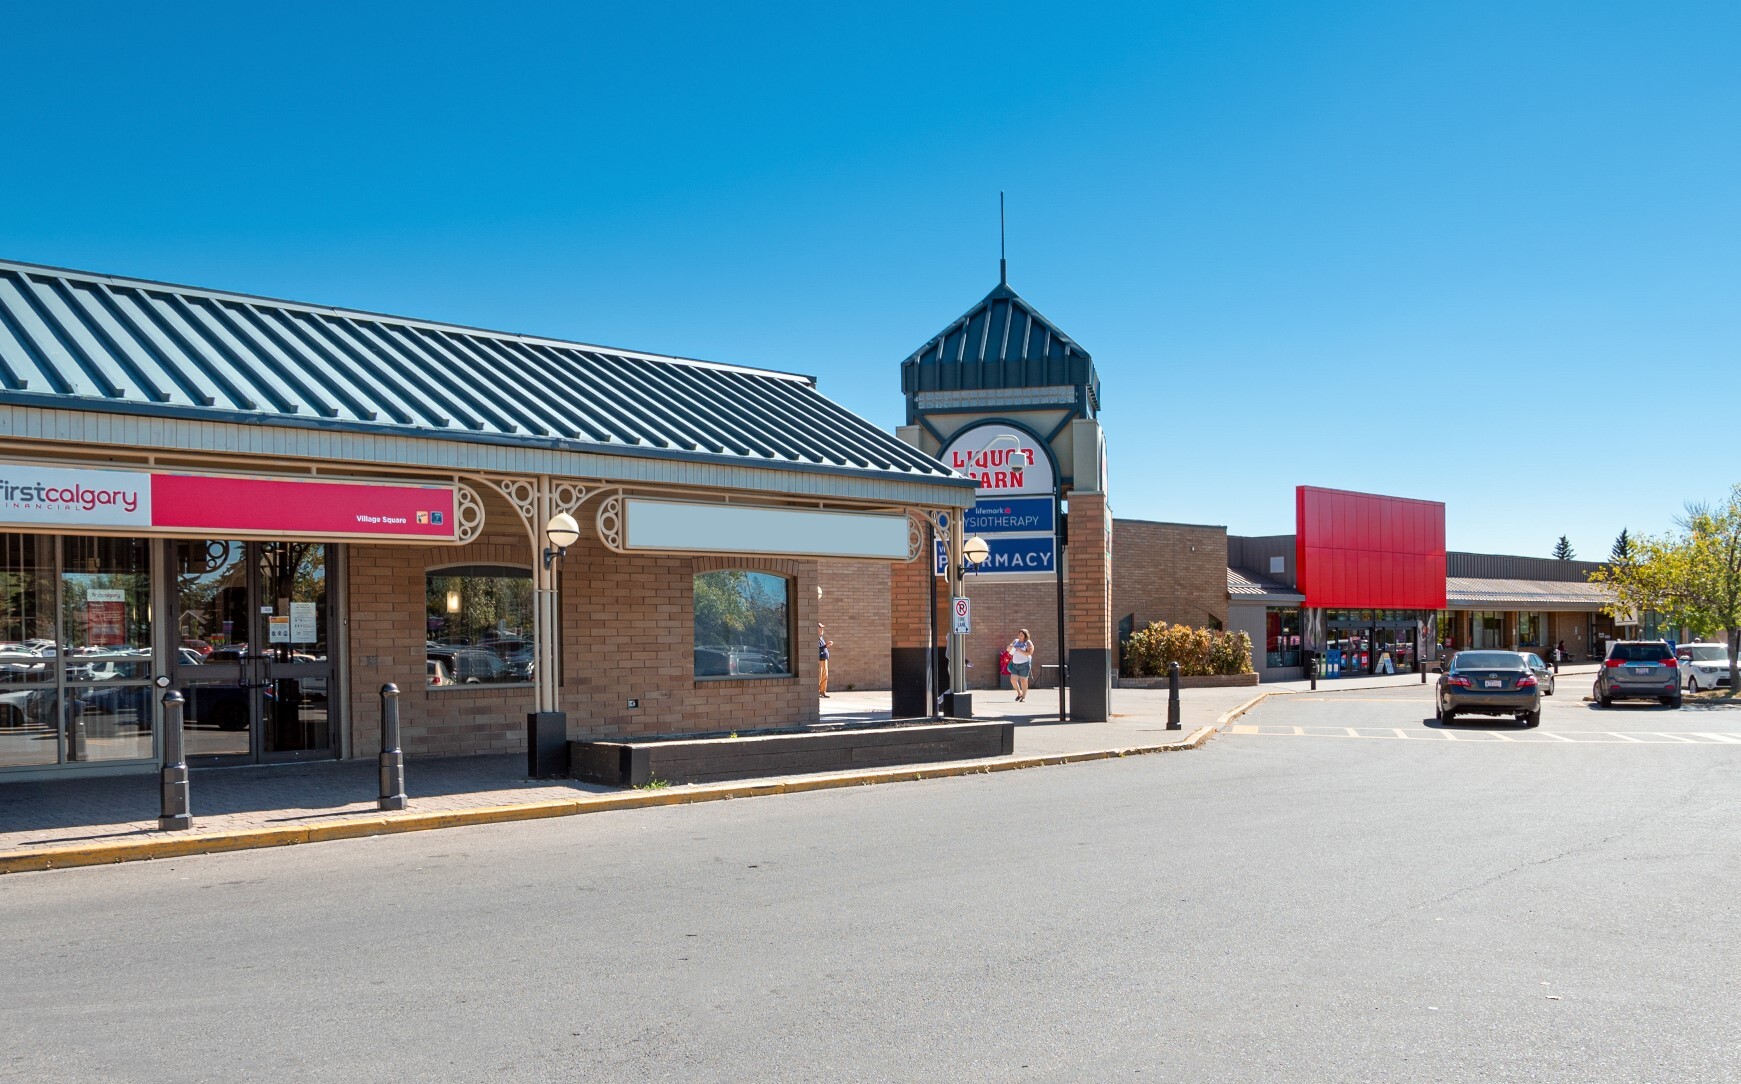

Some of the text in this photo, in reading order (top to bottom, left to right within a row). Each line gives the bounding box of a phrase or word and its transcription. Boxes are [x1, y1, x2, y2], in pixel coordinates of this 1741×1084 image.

[5, 502, 80, 510] INANCIAL
[975, 507, 1004, 515] lifemark
[356, 515, 407, 524] Village Square
[963, 515, 1039, 528] YSIOTHERAPY
[938, 552, 1052, 569] PRMACY
